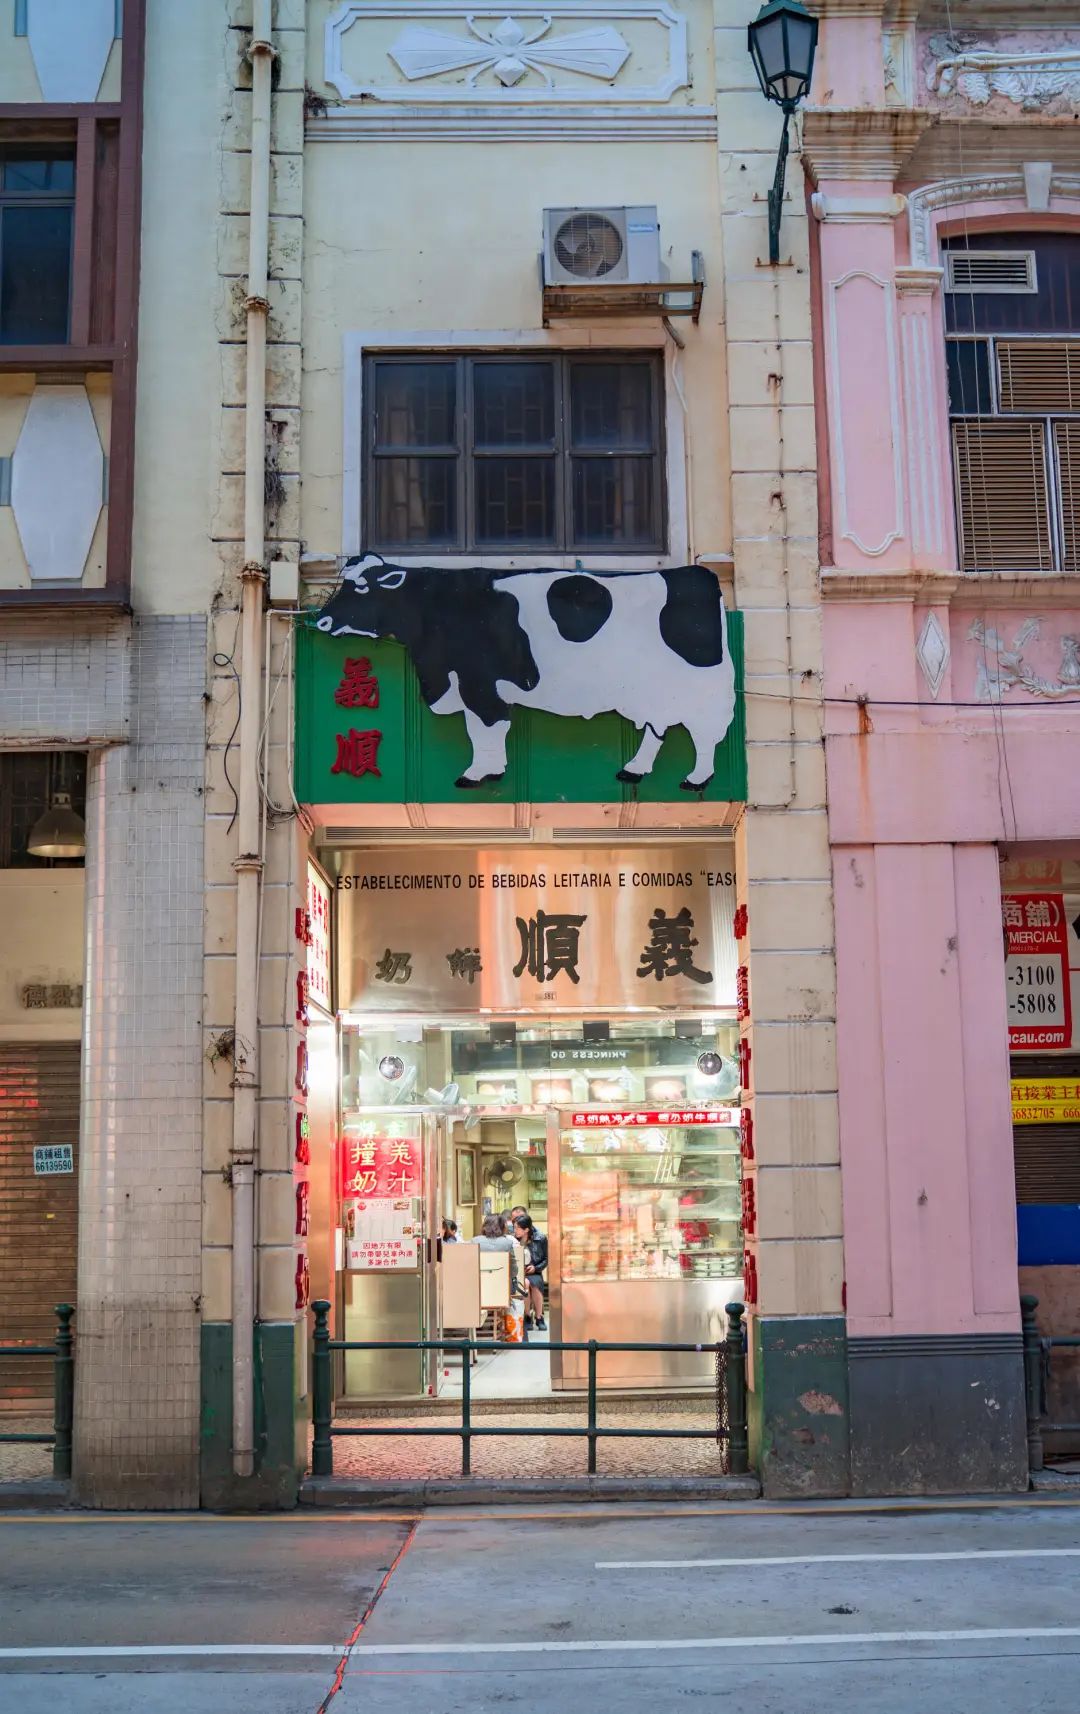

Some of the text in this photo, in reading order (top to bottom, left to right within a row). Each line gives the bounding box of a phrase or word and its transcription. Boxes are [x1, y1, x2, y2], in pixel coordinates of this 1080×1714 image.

[331, 655, 382, 778] 義順
[336, 874, 462, 890] ESTABELECIMENTO
[468, 874, 485, 889] DE
[492, 873, 546, 888] BEBIDAS
[554, 872, 612, 888] LEITARIA
[618, 872, 626, 887] E
[632, 872, 693, 887] COMIDAS
[1007, 930, 1062, 944] MERCIAL
